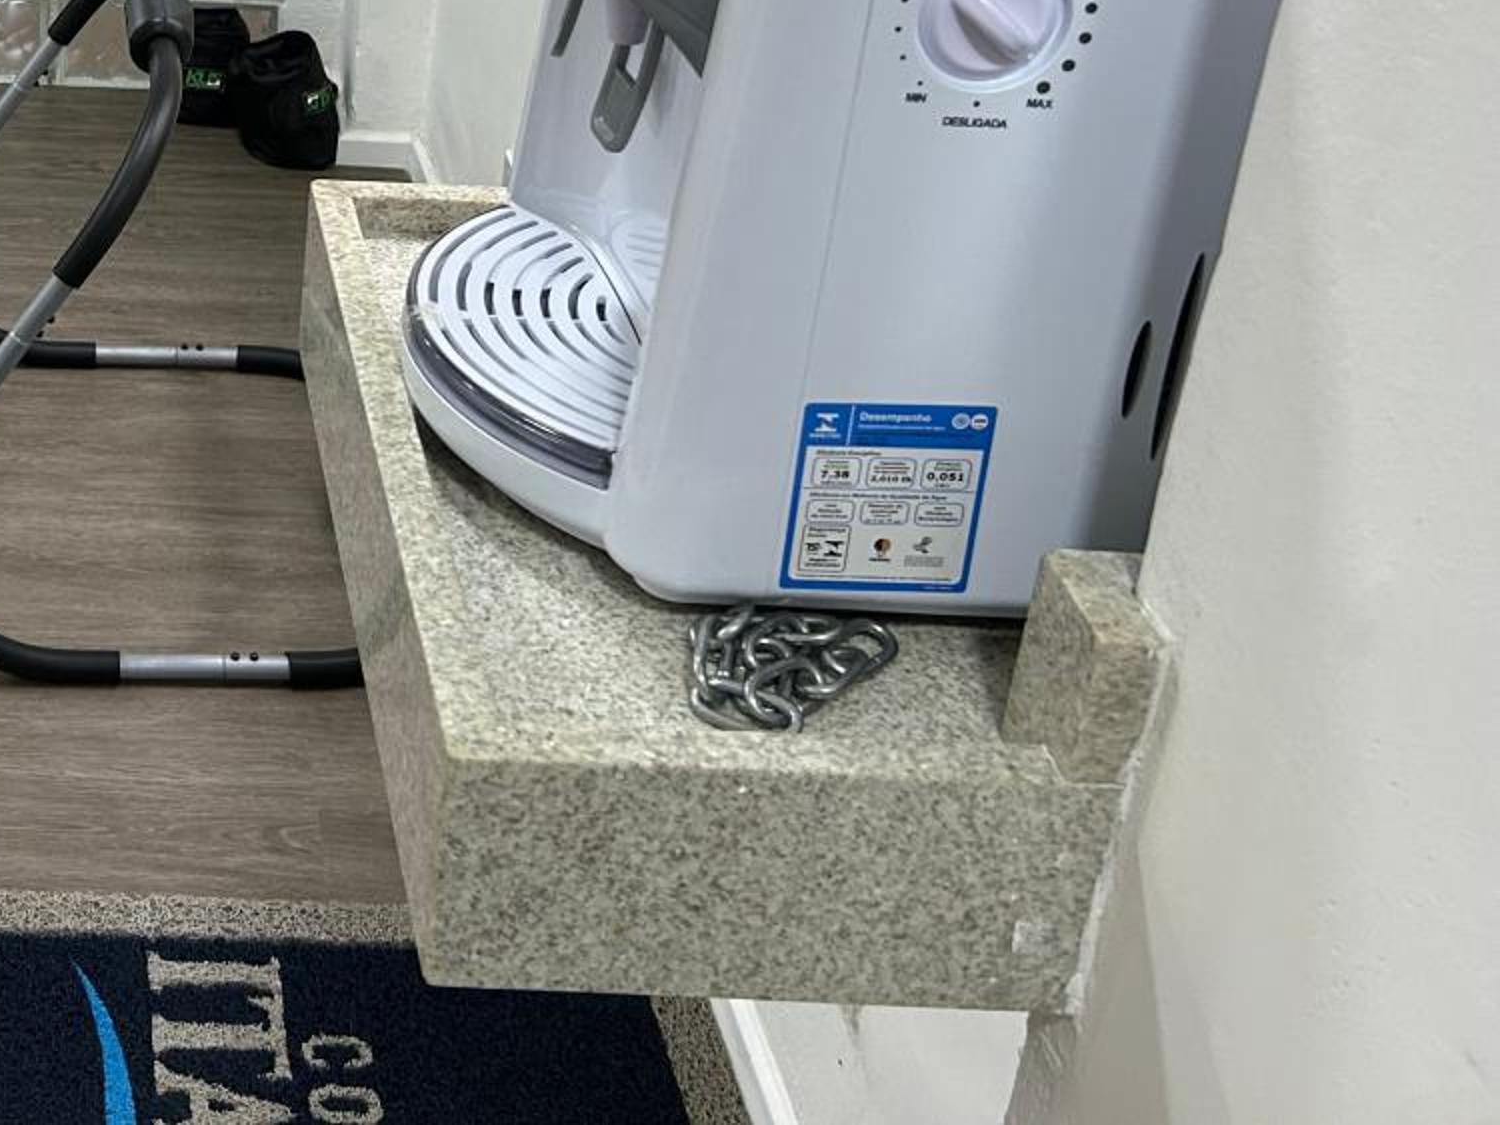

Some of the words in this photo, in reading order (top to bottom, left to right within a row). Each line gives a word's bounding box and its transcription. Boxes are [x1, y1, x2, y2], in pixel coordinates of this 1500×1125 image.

[905, 93, 927, 103] MIN
[1026, 98, 1053, 109] MAX
[942, 116, 1008, 129] DESLIGADA
